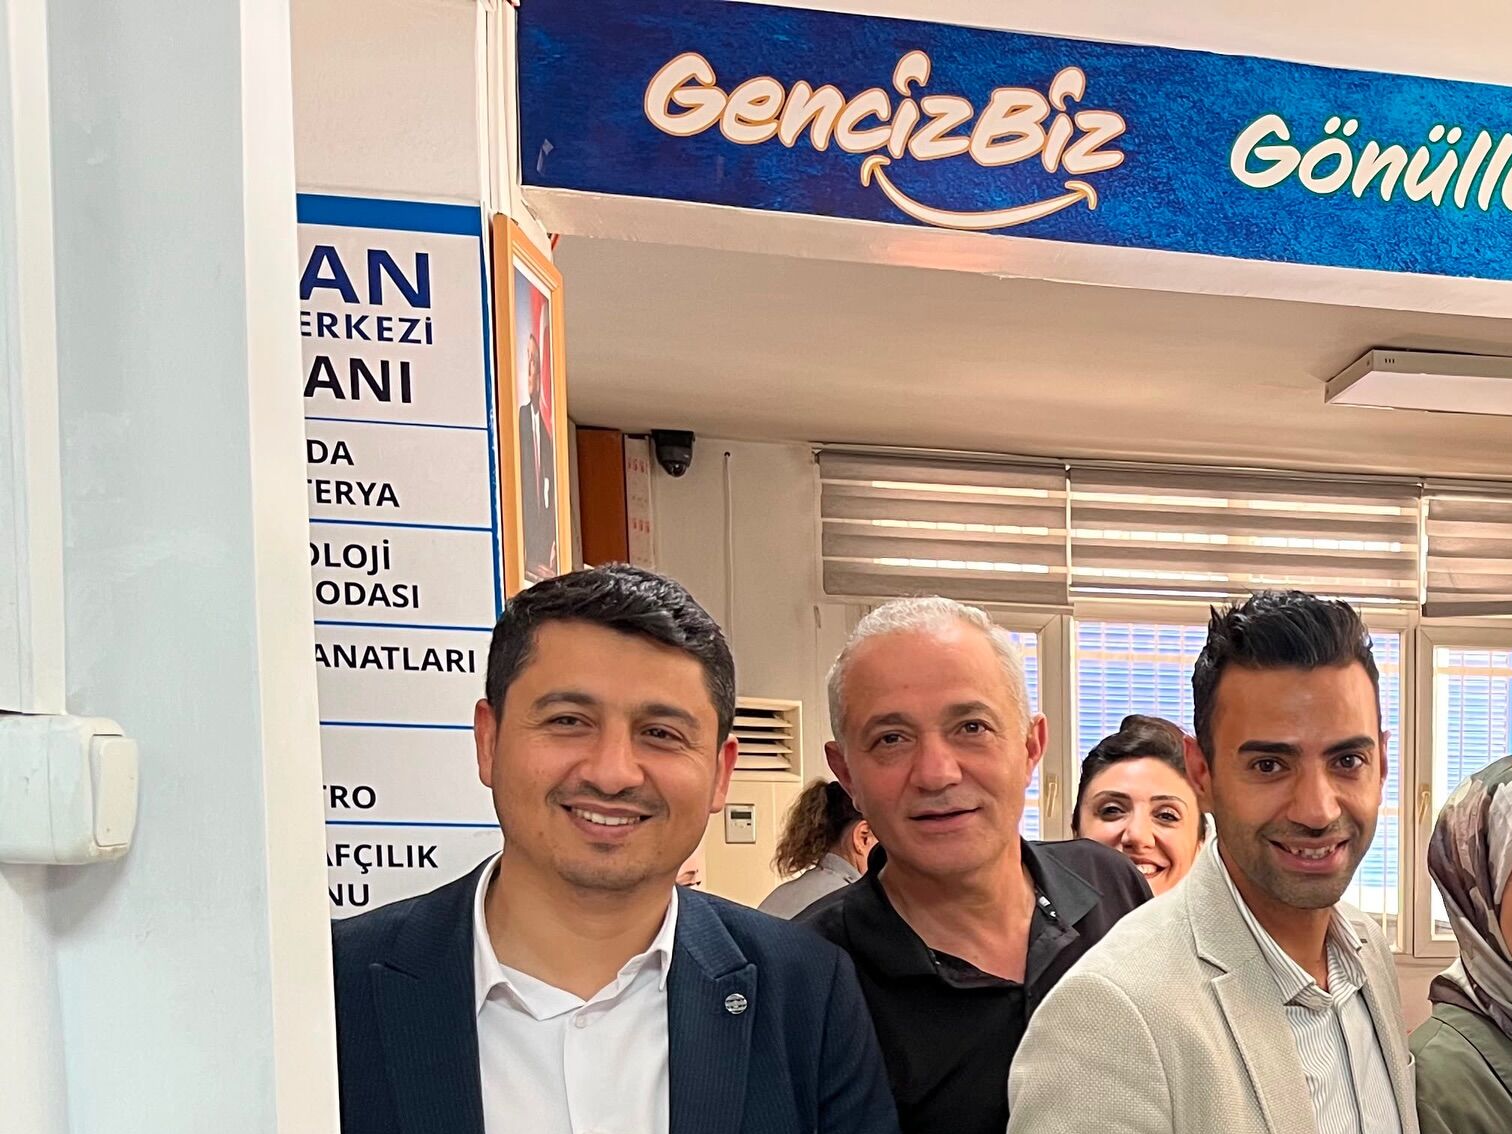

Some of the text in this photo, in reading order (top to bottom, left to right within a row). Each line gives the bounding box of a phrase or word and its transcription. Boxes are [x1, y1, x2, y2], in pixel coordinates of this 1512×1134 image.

[299, 245, 431, 309] AN
[303, 355, 412, 403] ANI
[307, 478, 400, 508] ERYA
[316, 580, 419, 609] ODASI
[315, 643, 476, 674] ANATLARI
[323, 785, 377, 809] RO
[327, 843, 439, 875] FÇILIK
